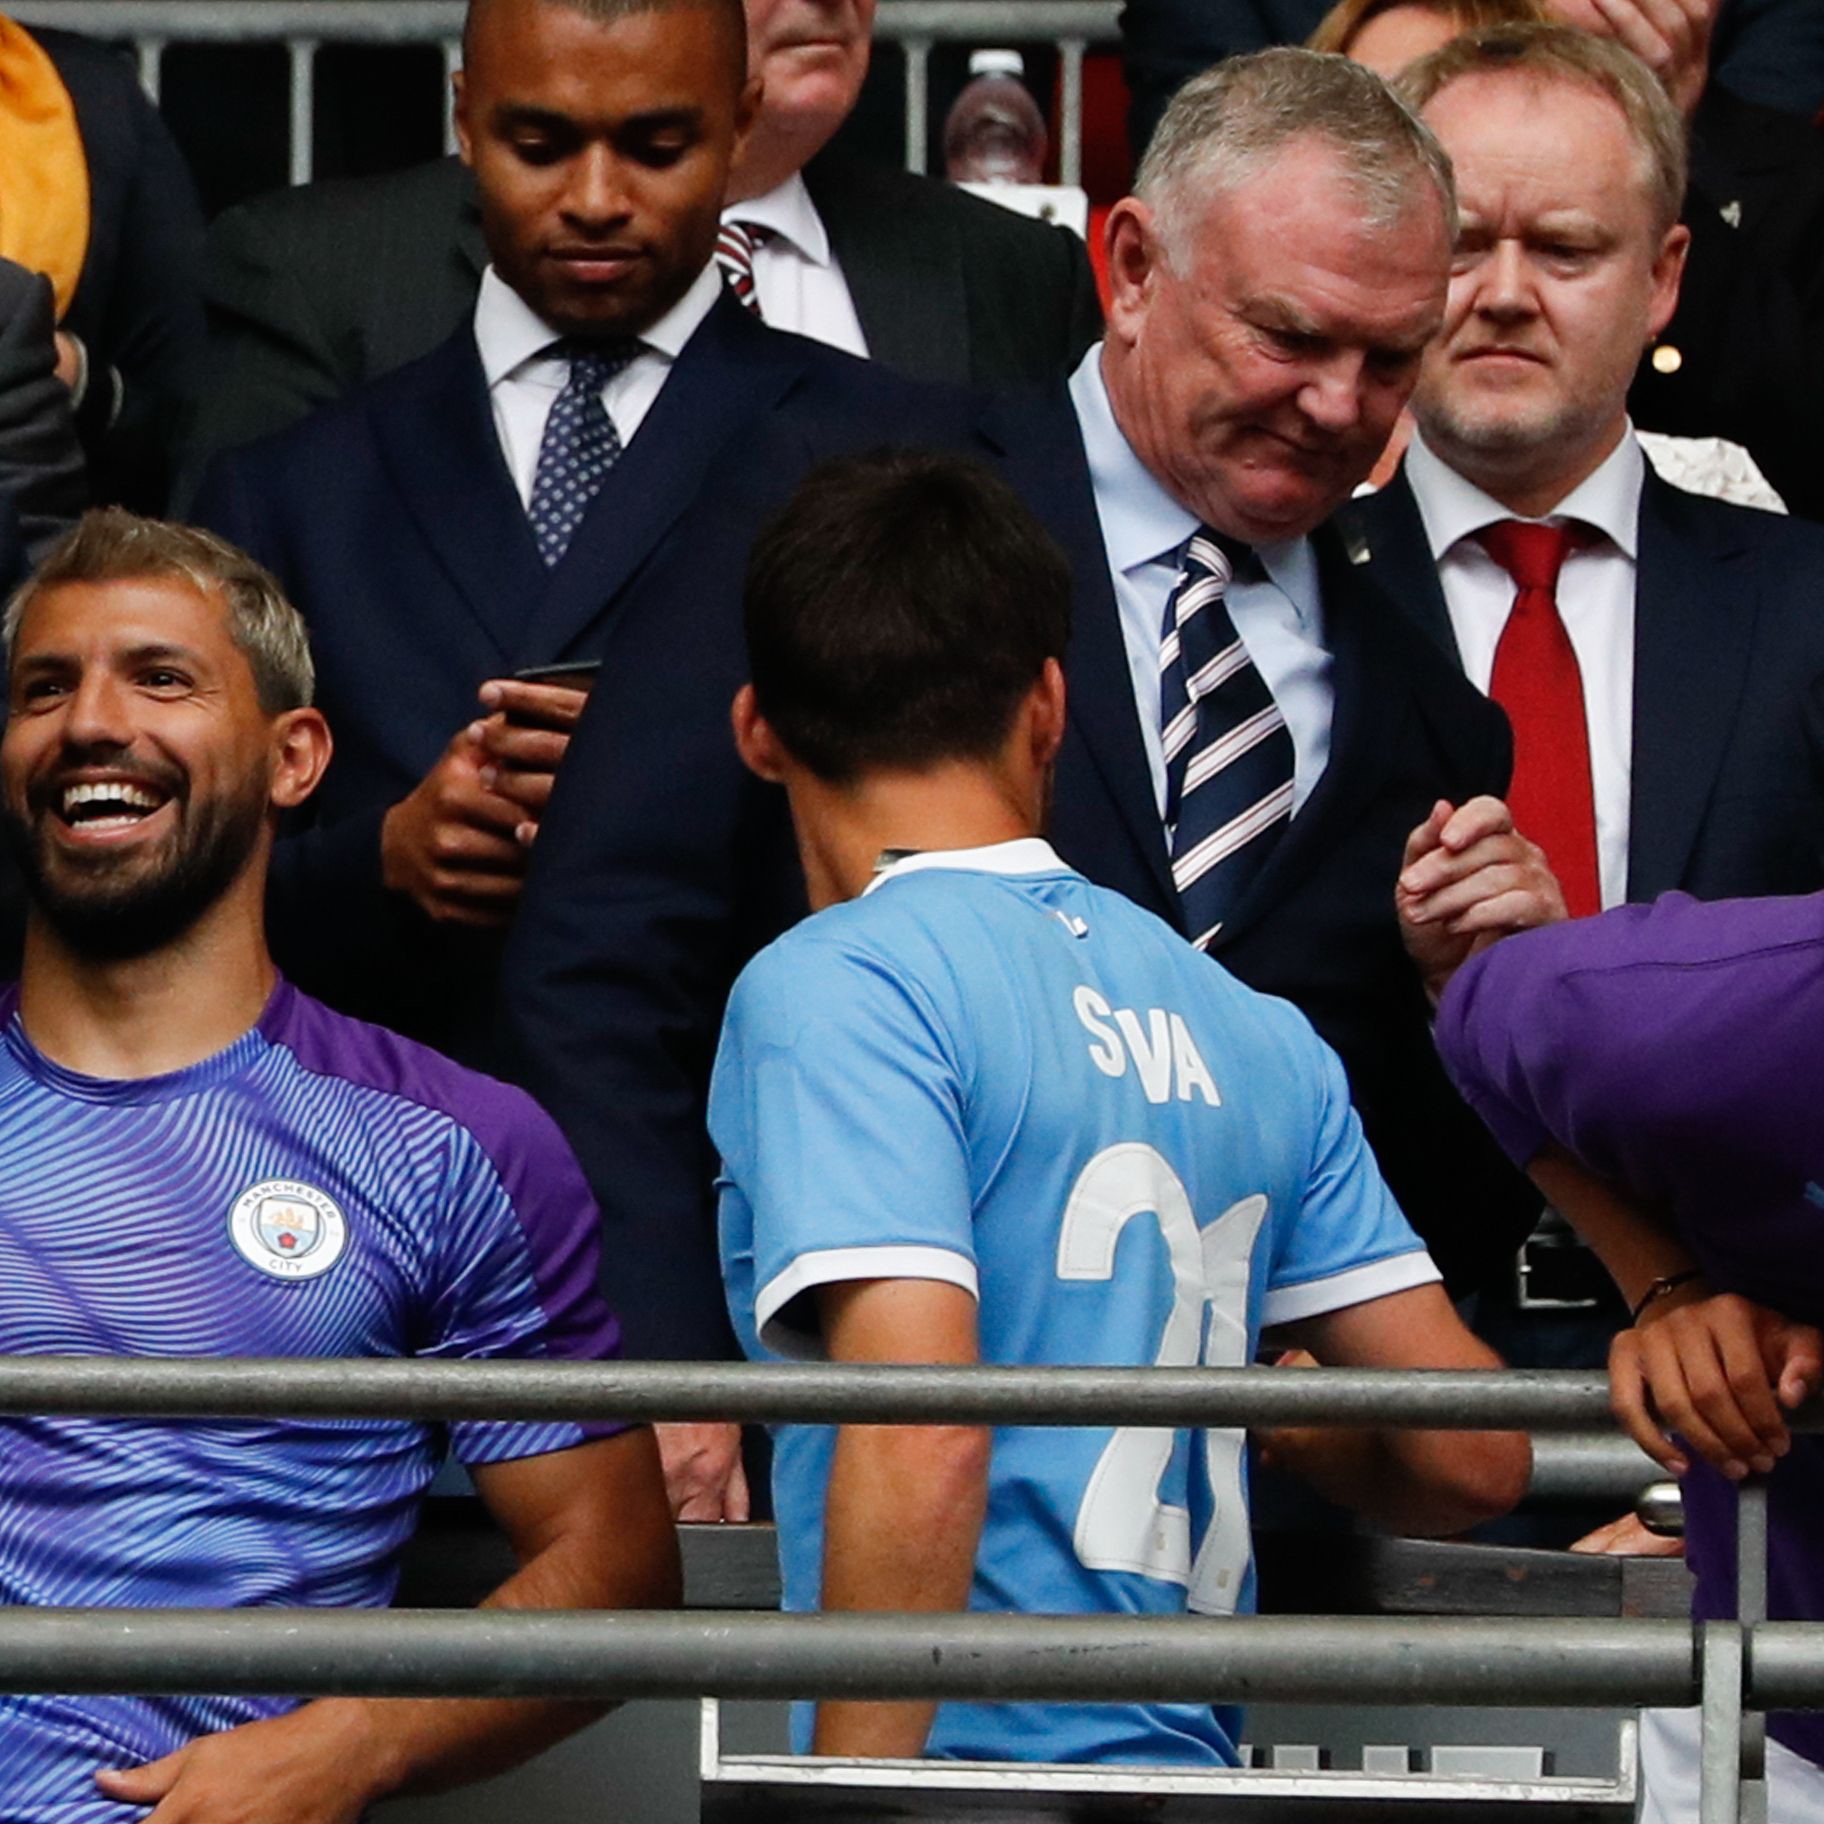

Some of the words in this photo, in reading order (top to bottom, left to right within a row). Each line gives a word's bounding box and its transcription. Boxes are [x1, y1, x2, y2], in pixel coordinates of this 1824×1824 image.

[243, 1183, 336, 1218] MANCHESTER
[269, 1259, 303, 1273] CITY
[1056, 1141, 1268, 1616] 21
